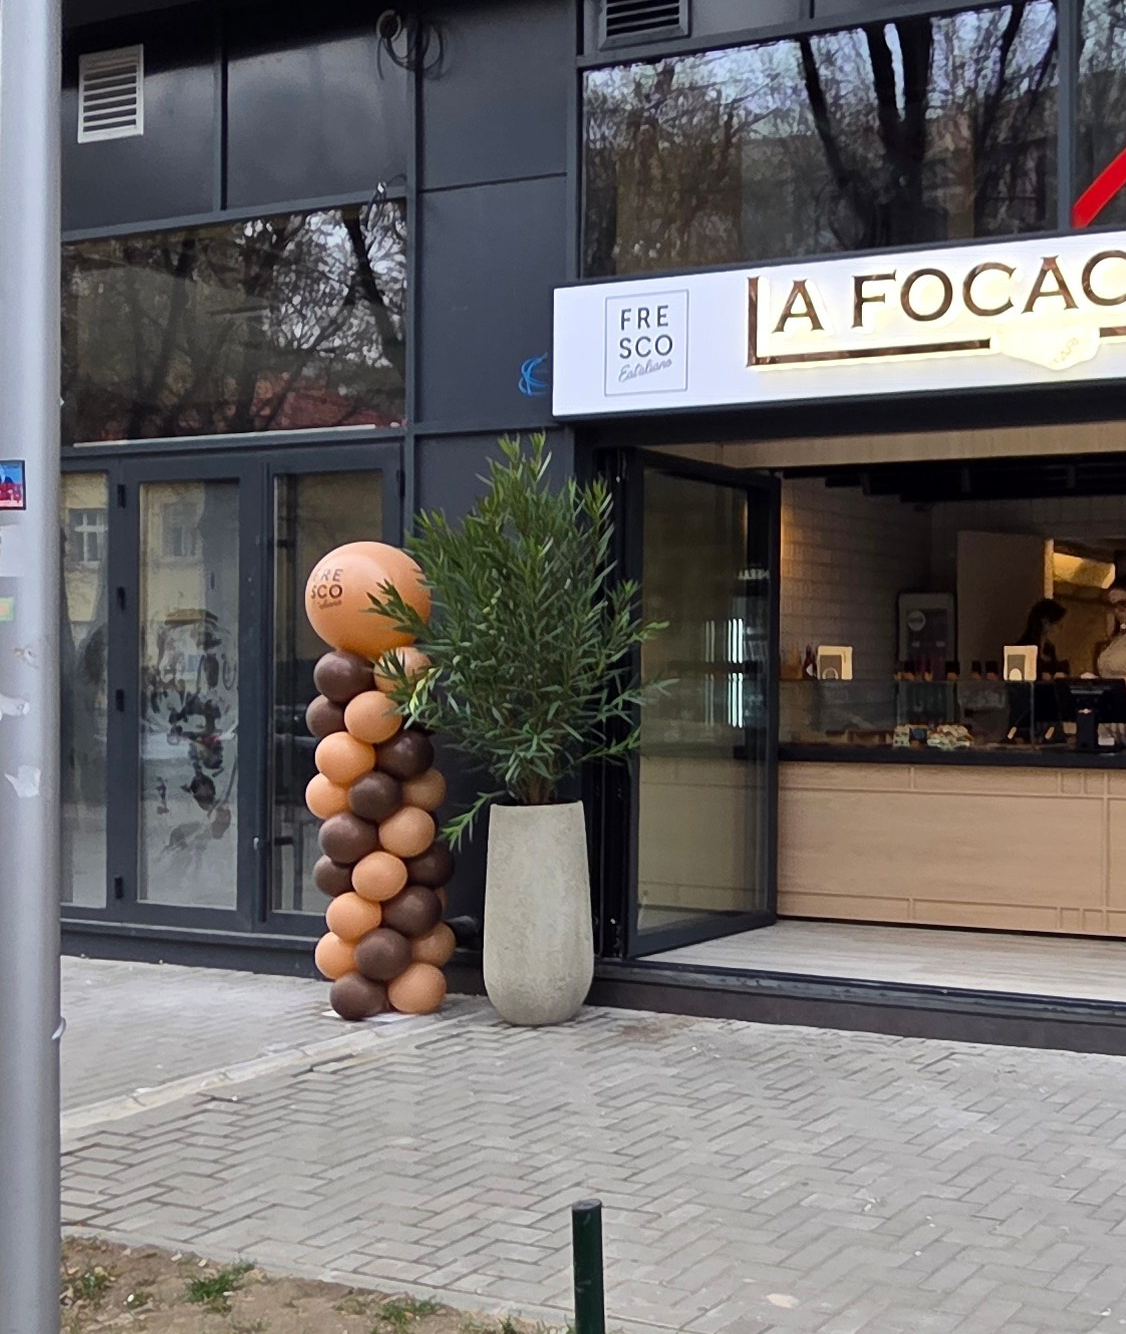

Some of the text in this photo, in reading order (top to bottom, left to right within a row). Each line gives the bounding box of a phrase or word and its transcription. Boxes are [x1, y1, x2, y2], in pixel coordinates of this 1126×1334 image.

[620, 304, 669, 331] FRE
[747, 275, 825, 368] LA
[619, 334, 673, 359] SCO
[310, 584, 343, 600] SCO
